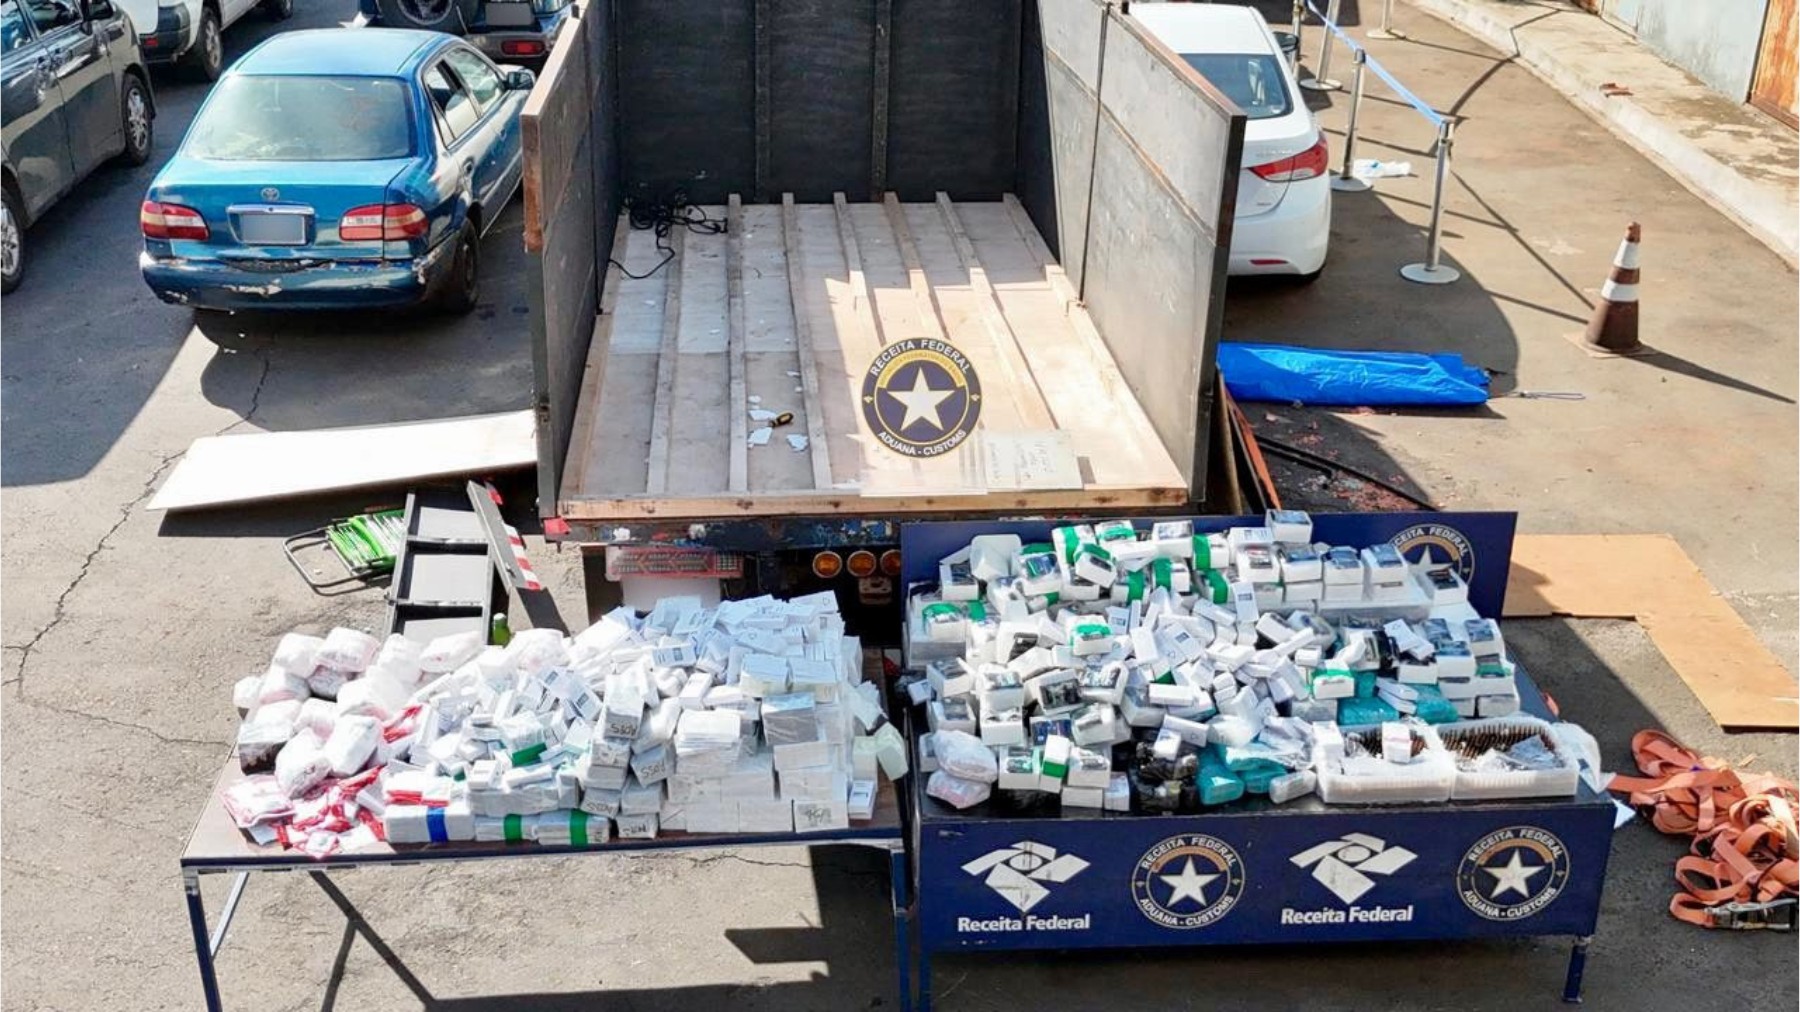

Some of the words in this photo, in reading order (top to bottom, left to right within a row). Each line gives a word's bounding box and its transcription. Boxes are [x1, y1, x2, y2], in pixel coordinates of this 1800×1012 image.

[1429, 526, 1469, 557] FEDERAL
[1142, 837, 1186, 870] RECEITA
[1191, 836, 1238, 867] FEDERAL
[1468, 830, 1514, 862] RECEITA
[1519, 828, 1564, 860] FEDERAL
[1139, 897, 1179, 927] ADUANA
[1185, 895, 1234, 927] CUSTOMS
[1281, 907, 1345, 925] Receita
[1348, 905, 1414, 923] Federal
[1463, 889, 1500, 918] ADUANA
[1506, 887, 1557, 919] CUSTOMS
[957, 916, 1023, 933] Receita
[1026, 914, 1090, 931] Federal
